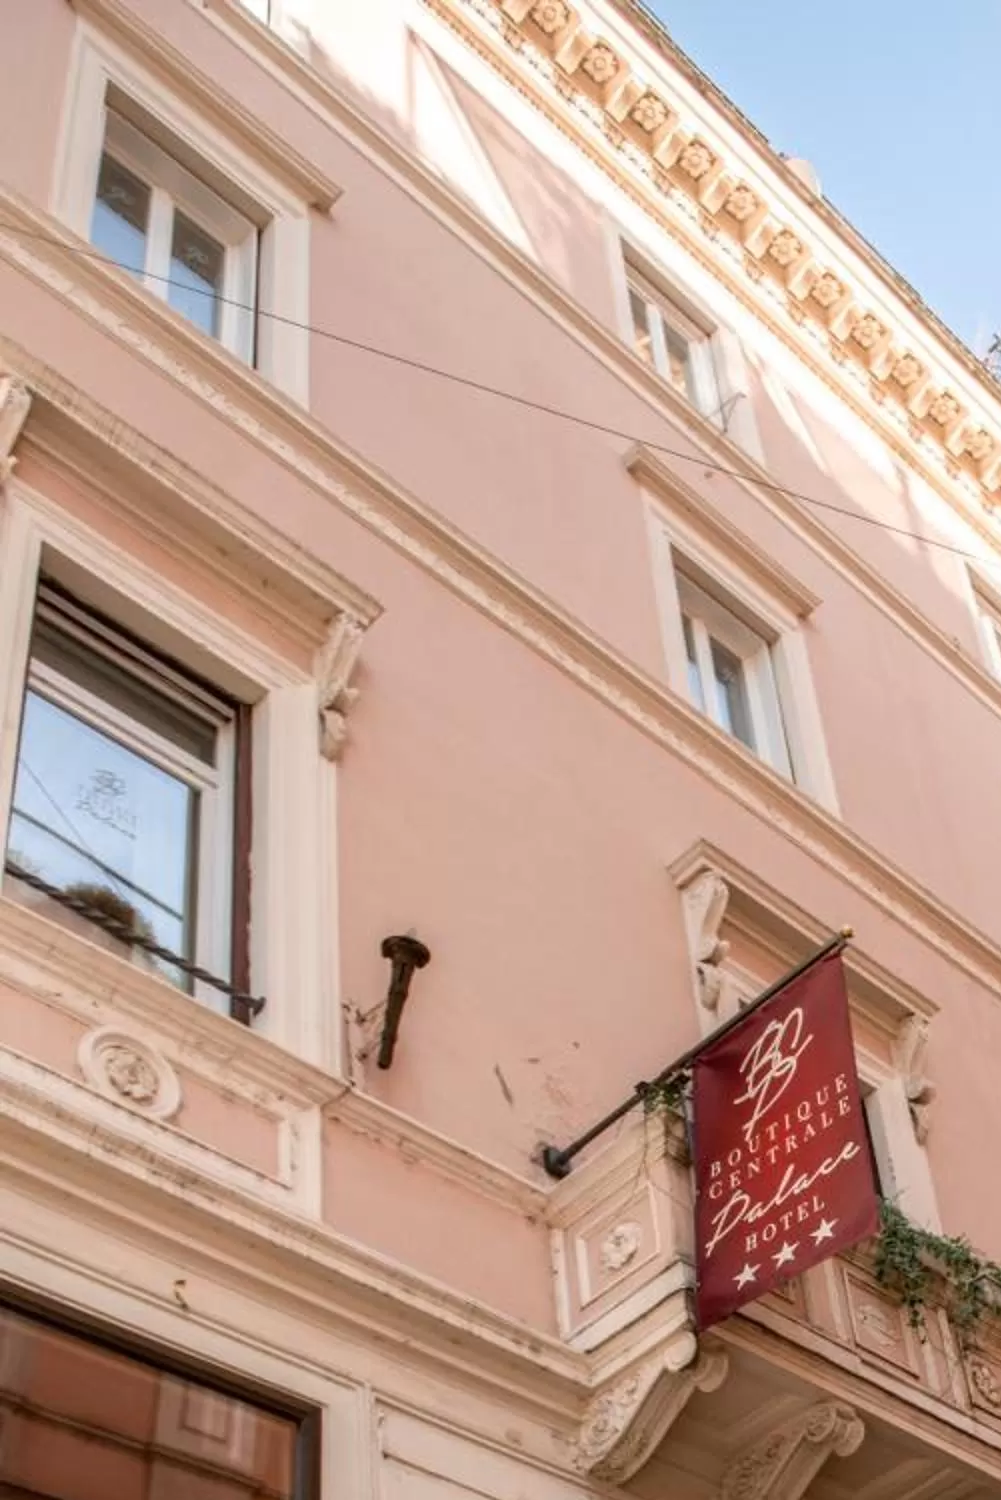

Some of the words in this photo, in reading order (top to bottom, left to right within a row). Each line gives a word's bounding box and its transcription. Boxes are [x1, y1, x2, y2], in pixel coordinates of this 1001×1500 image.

[708, 1095, 852, 1200] CENTRALE
[710, 1073, 848, 1178] BOUTIQUE
[705, 1140, 861, 1260] Palace
[744, 1197, 825, 1253] HOTEL
